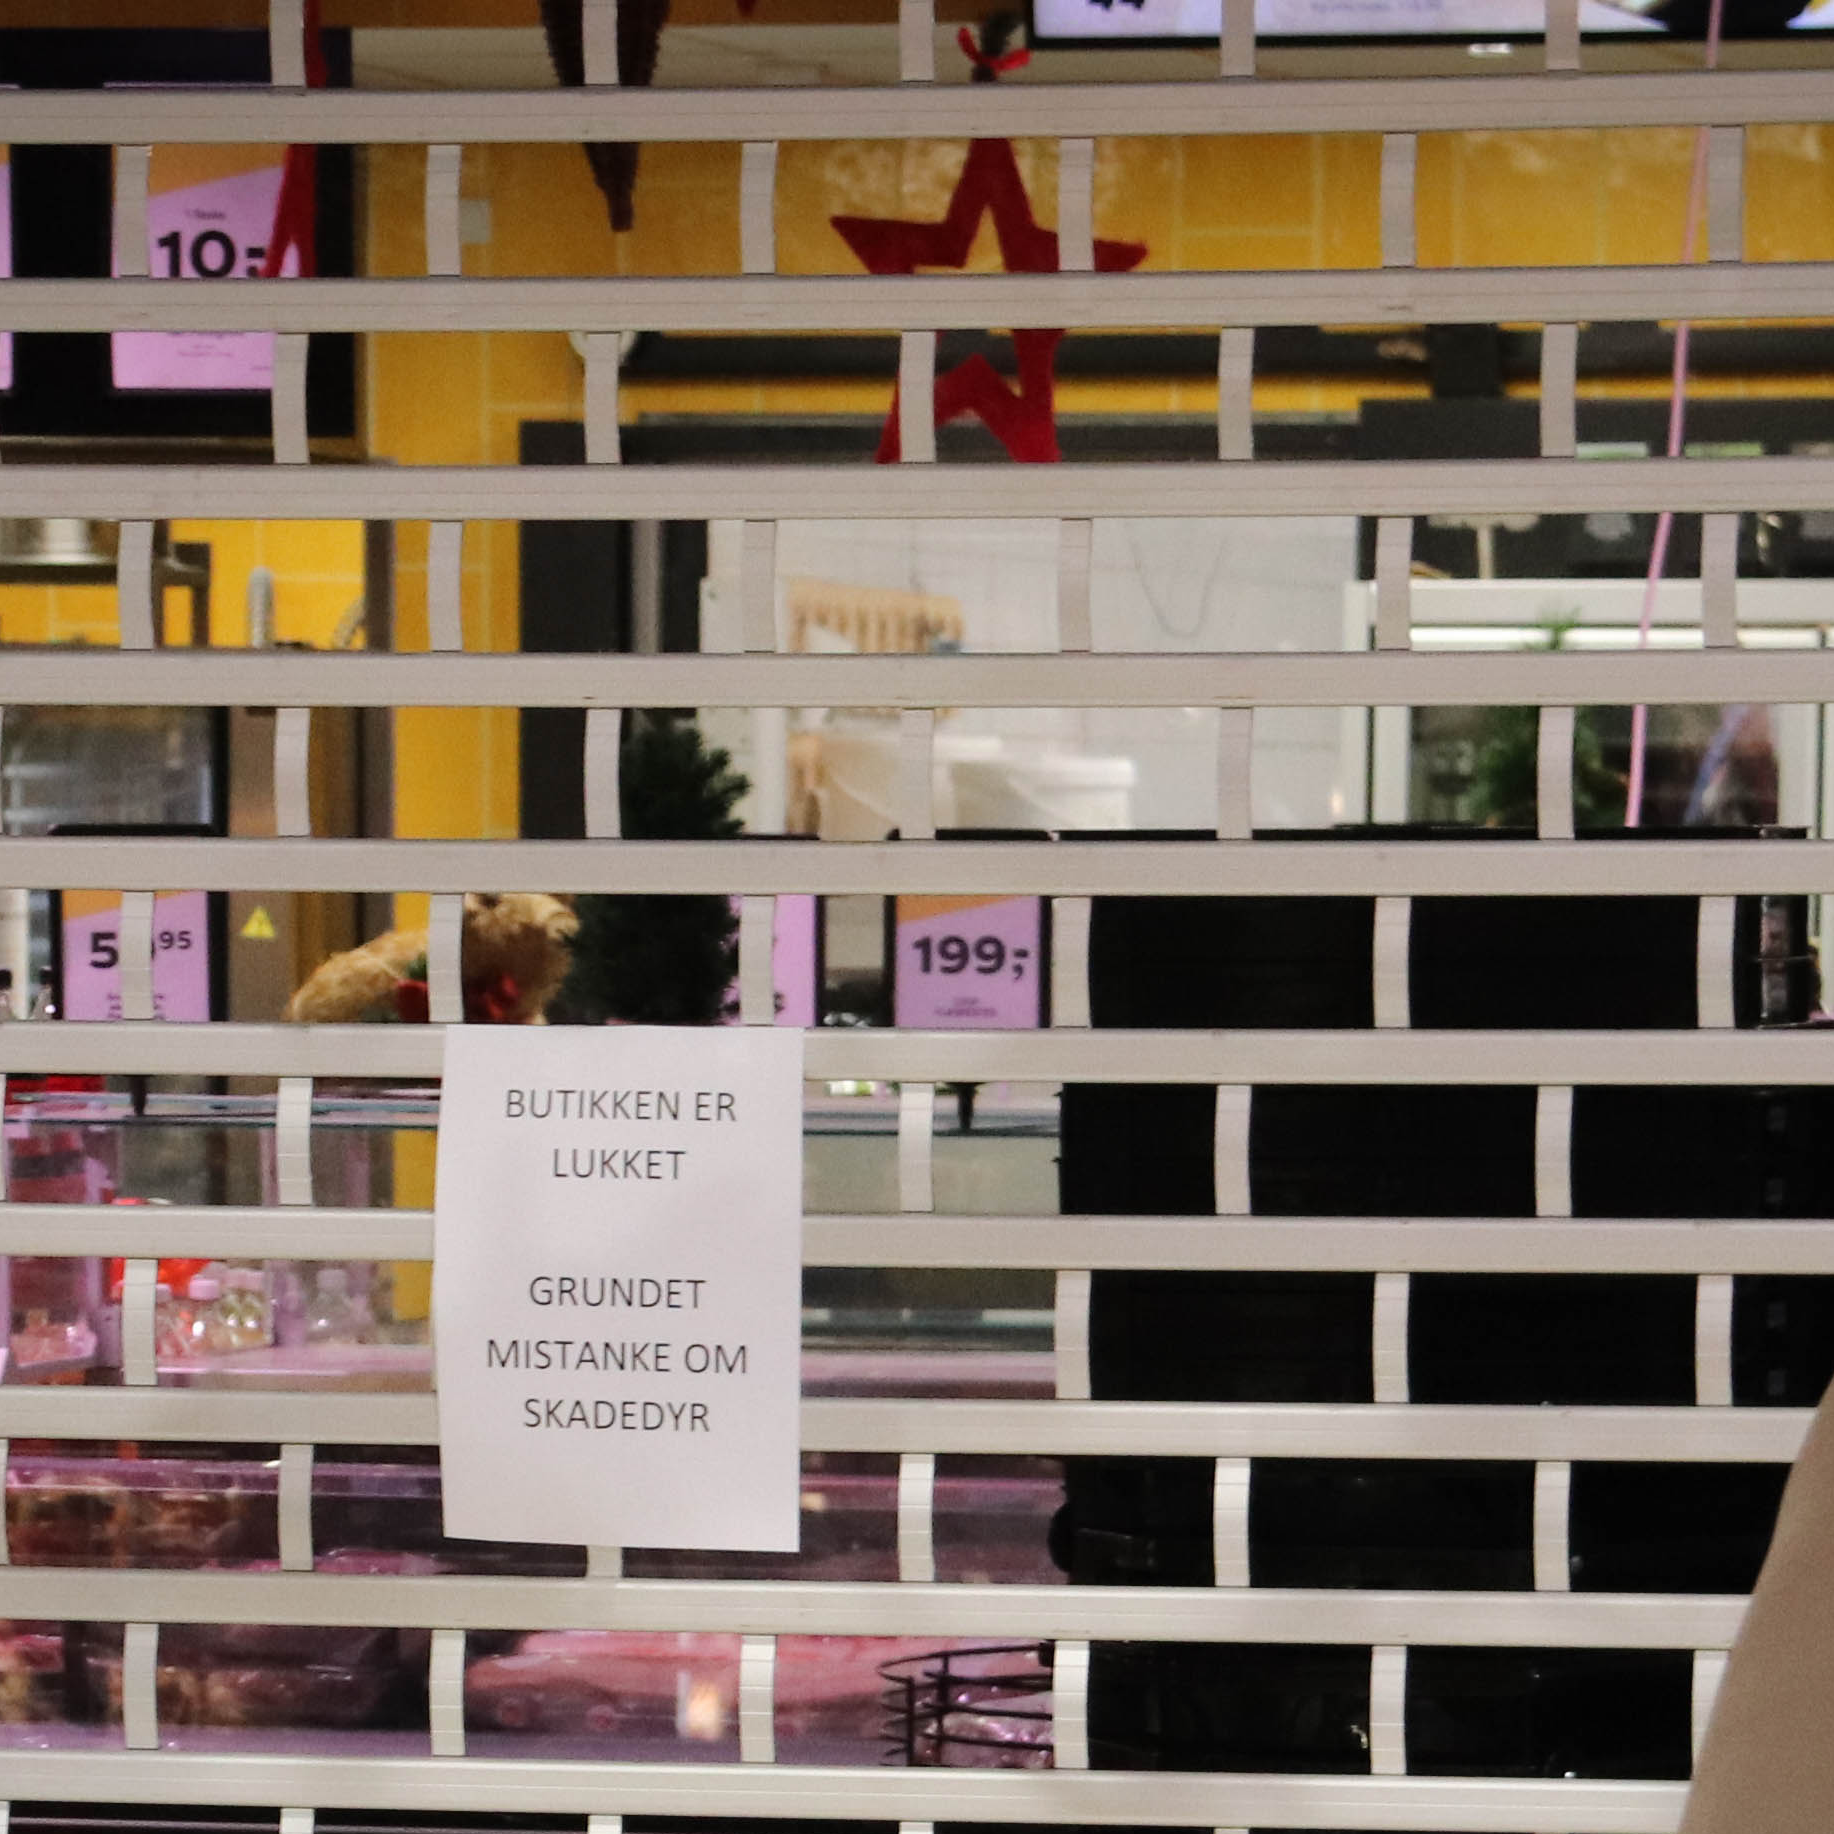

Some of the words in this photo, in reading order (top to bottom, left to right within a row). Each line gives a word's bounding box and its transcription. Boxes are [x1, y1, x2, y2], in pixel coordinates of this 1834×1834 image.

[505, 1088, 680, 1121] BUTIKKEN
[694, 1091, 737, 1122] ER
[552, 1147, 686, 1181] LUKKET
[529, 1275, 707, 1309] GRUNDET
[486, 1339, 672, 1373] MISTANKE
[684, 1343, 748, 1375] OM
[523, 1398, 710, 1432] SKADEDYR
